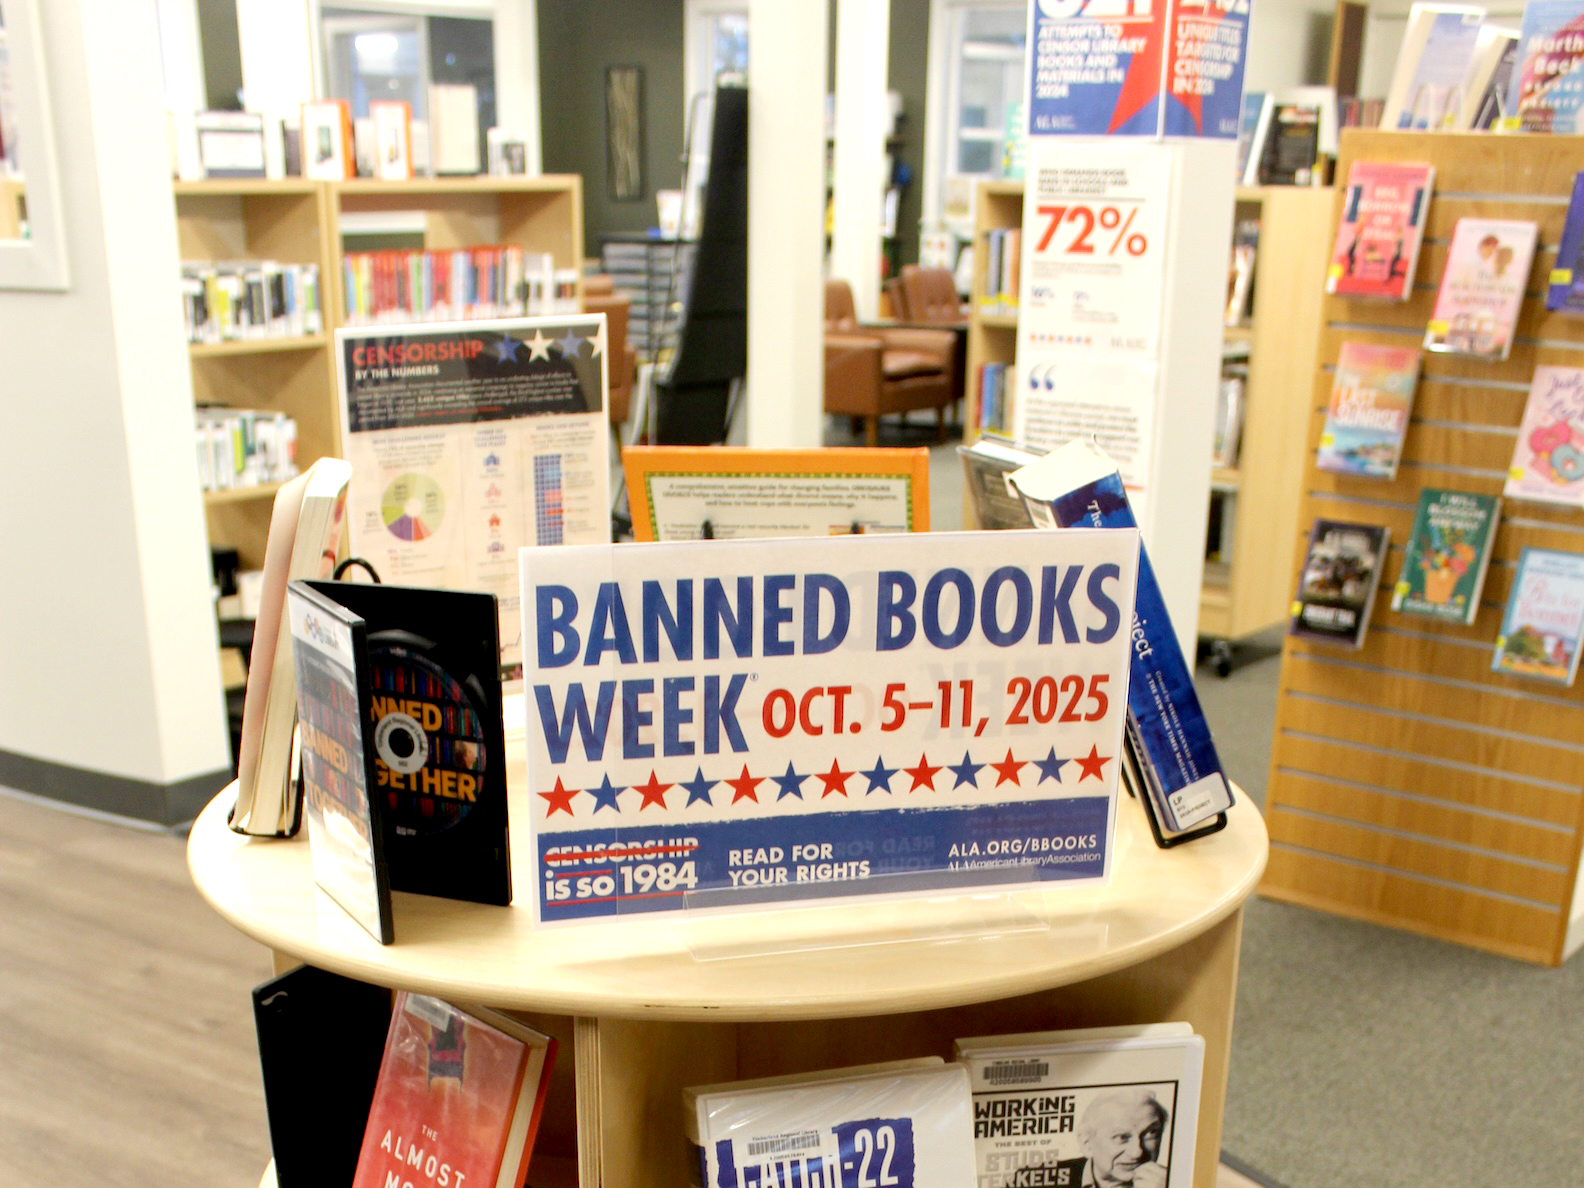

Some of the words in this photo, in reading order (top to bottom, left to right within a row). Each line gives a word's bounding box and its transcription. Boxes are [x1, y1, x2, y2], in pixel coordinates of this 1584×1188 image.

[1104, 24, 1124, 38] TO
[1528, 34, 1584, 54] Marth
[1038, 39, 1090, 54] CENSOR
[1092, 37, 1147, 54] LIBRARY
[1037, 54, 1085, 69] BOOKS
[1086, 53, 1119, 68] AND
[1107, 69, 1125, 83] IN
[1035, 206, 1148, 256] 72%
[352, 340, 484, 367] CENSORSHIP
[391, 364, 440, 377] NUMBERS
[1087, 500, 1103, 527] The
[535, 573, 851, 669] BANNED
[876, 563, 1121, 652] BOOKS
[1132, 611, 1153, 660] ject
[371, 694, 442, 732] NNED
[761, 685, 862, 738] OCT.
[1005, 674, 1110, 726] 2025
[301, 718, 348, 774] BANNED
[1148, 679, 1156, 691] THE
[1154, 692, 1163, 711] NEW
[1160, 711, 1171, 731] YORK
[1167, 730, 1179, 752] TIMES
[1175, 751, 1191, 786] MAGAZIN
[375, 758, 478, 802] GETHER
[544, 837, 699, 867] CENSORSHIP
[728, 846, 784, 867] READ
[791, 842, 833, 863] FOR
[948, 834, 1097, 858] ALA.ORG/BBOOKS
[545, 870, 571, 900] is
[576, 875, 615, 898] so
[620, 861, 698, 894] 1984
[728, 865, 792, 887] YOUR
[796, 860, 871, 883] RIGHTS
[975, 1095, 1075, 1119] WORKING
[421, 1123, 438, 1142] THE
[974, 1115, 1074, 1139] AMERICA
[985, 1149, 1059, 1172] STUDS
